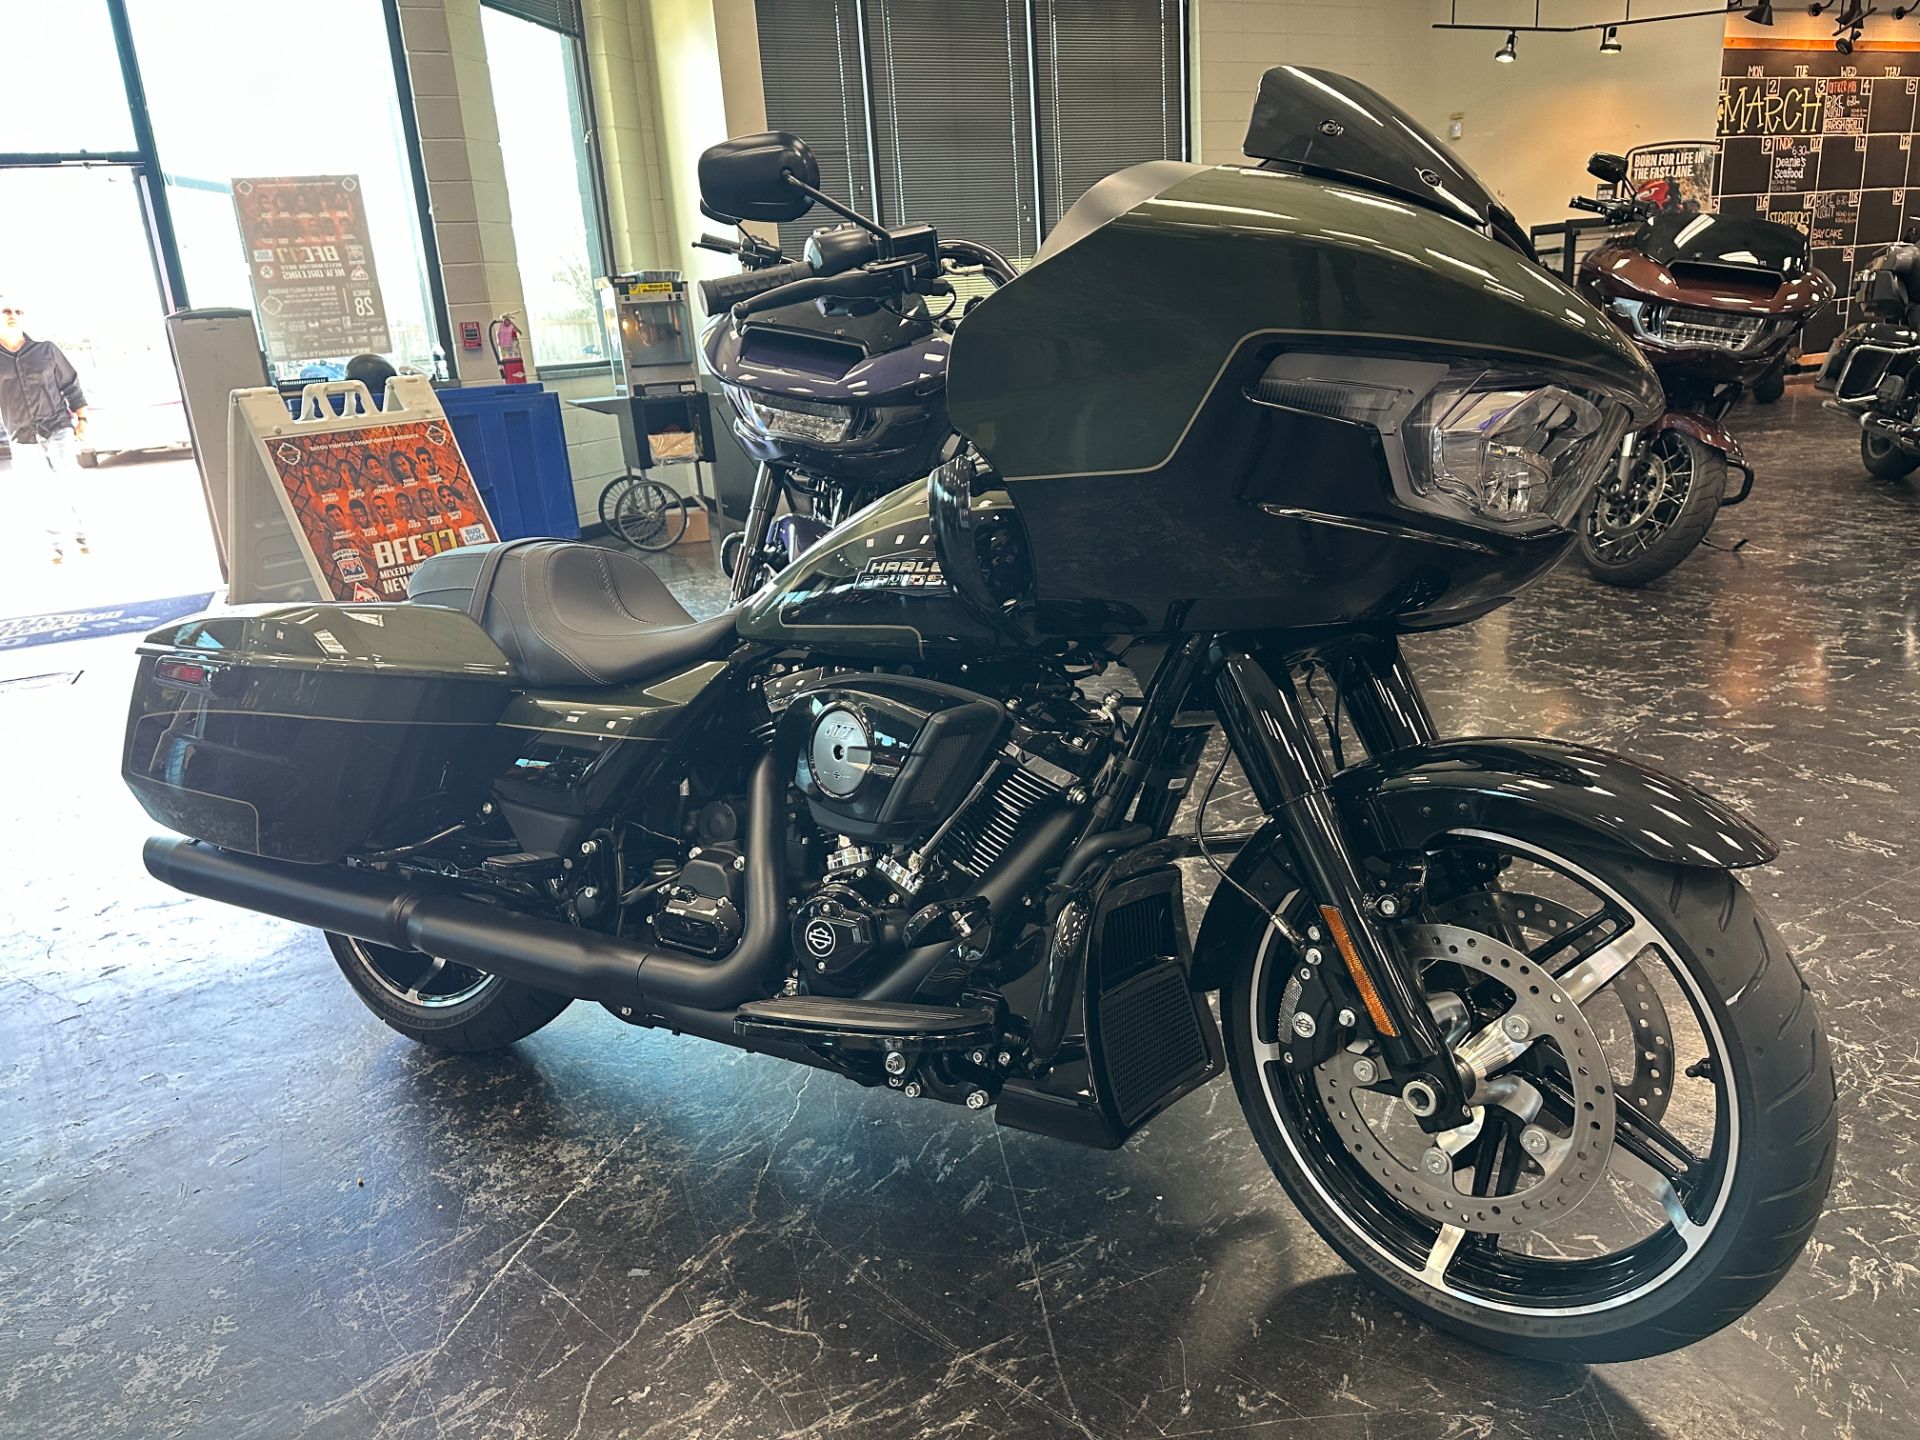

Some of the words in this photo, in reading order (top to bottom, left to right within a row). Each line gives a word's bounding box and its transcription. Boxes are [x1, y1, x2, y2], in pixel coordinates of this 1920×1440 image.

[1747, 65, 1764, 77] MON
[1794, 65, 1809, 77] TUE
[1841, 66, 1857, 77] WED
[1885, 66, 1900, 77] THU
[1720, 79, 1726, 92] 1
[1769, 80, 1777, 93] 2
[1818, 80, 1826, 93] 3
[1863, 80, 1870, 93] 4
[1908, 80, 1916, 91] 5
[1721, 86, 1822, 134] MARCH
[1765, 139, 1772, 151] 9
[1812, 138, 1820, 149] 10
[1857, 137, 1865, 148] 11
[1902, 136, 1910, 147] 12
[1634, 154, 1657, 167] BORN
[1658, 152, 1675, 166] FOR
[1675, 151, 1694, 165] LIFE
[1695, 151, 1705, 164] IN
[1634, 168, 1649, 180] THE
[1649, 166, 1670, 178] FAST
[1774, 168, 1804, 179] Seafood
[1759, 196, 1768, 208] 16
[1807, 194, 1815, 206] 17
[1816, 192, 1835, 207] BIKE
[1851, 191, 1859, 203] 18
[1894, 189, 1903, 203] 19
[1815, 205, 1836, 219] NIGHT
[1845, 247, 1854, 257] 25
[465, 527, 481, 536] BUD
[464, 533, 486, 543] LIGHT
[380, 566, 406, 580] MIXED
[870, 561, 942, 573] HARLE
[860, 574, 948, 586] DAVIDS
[825, 722, 856, 740] 117
